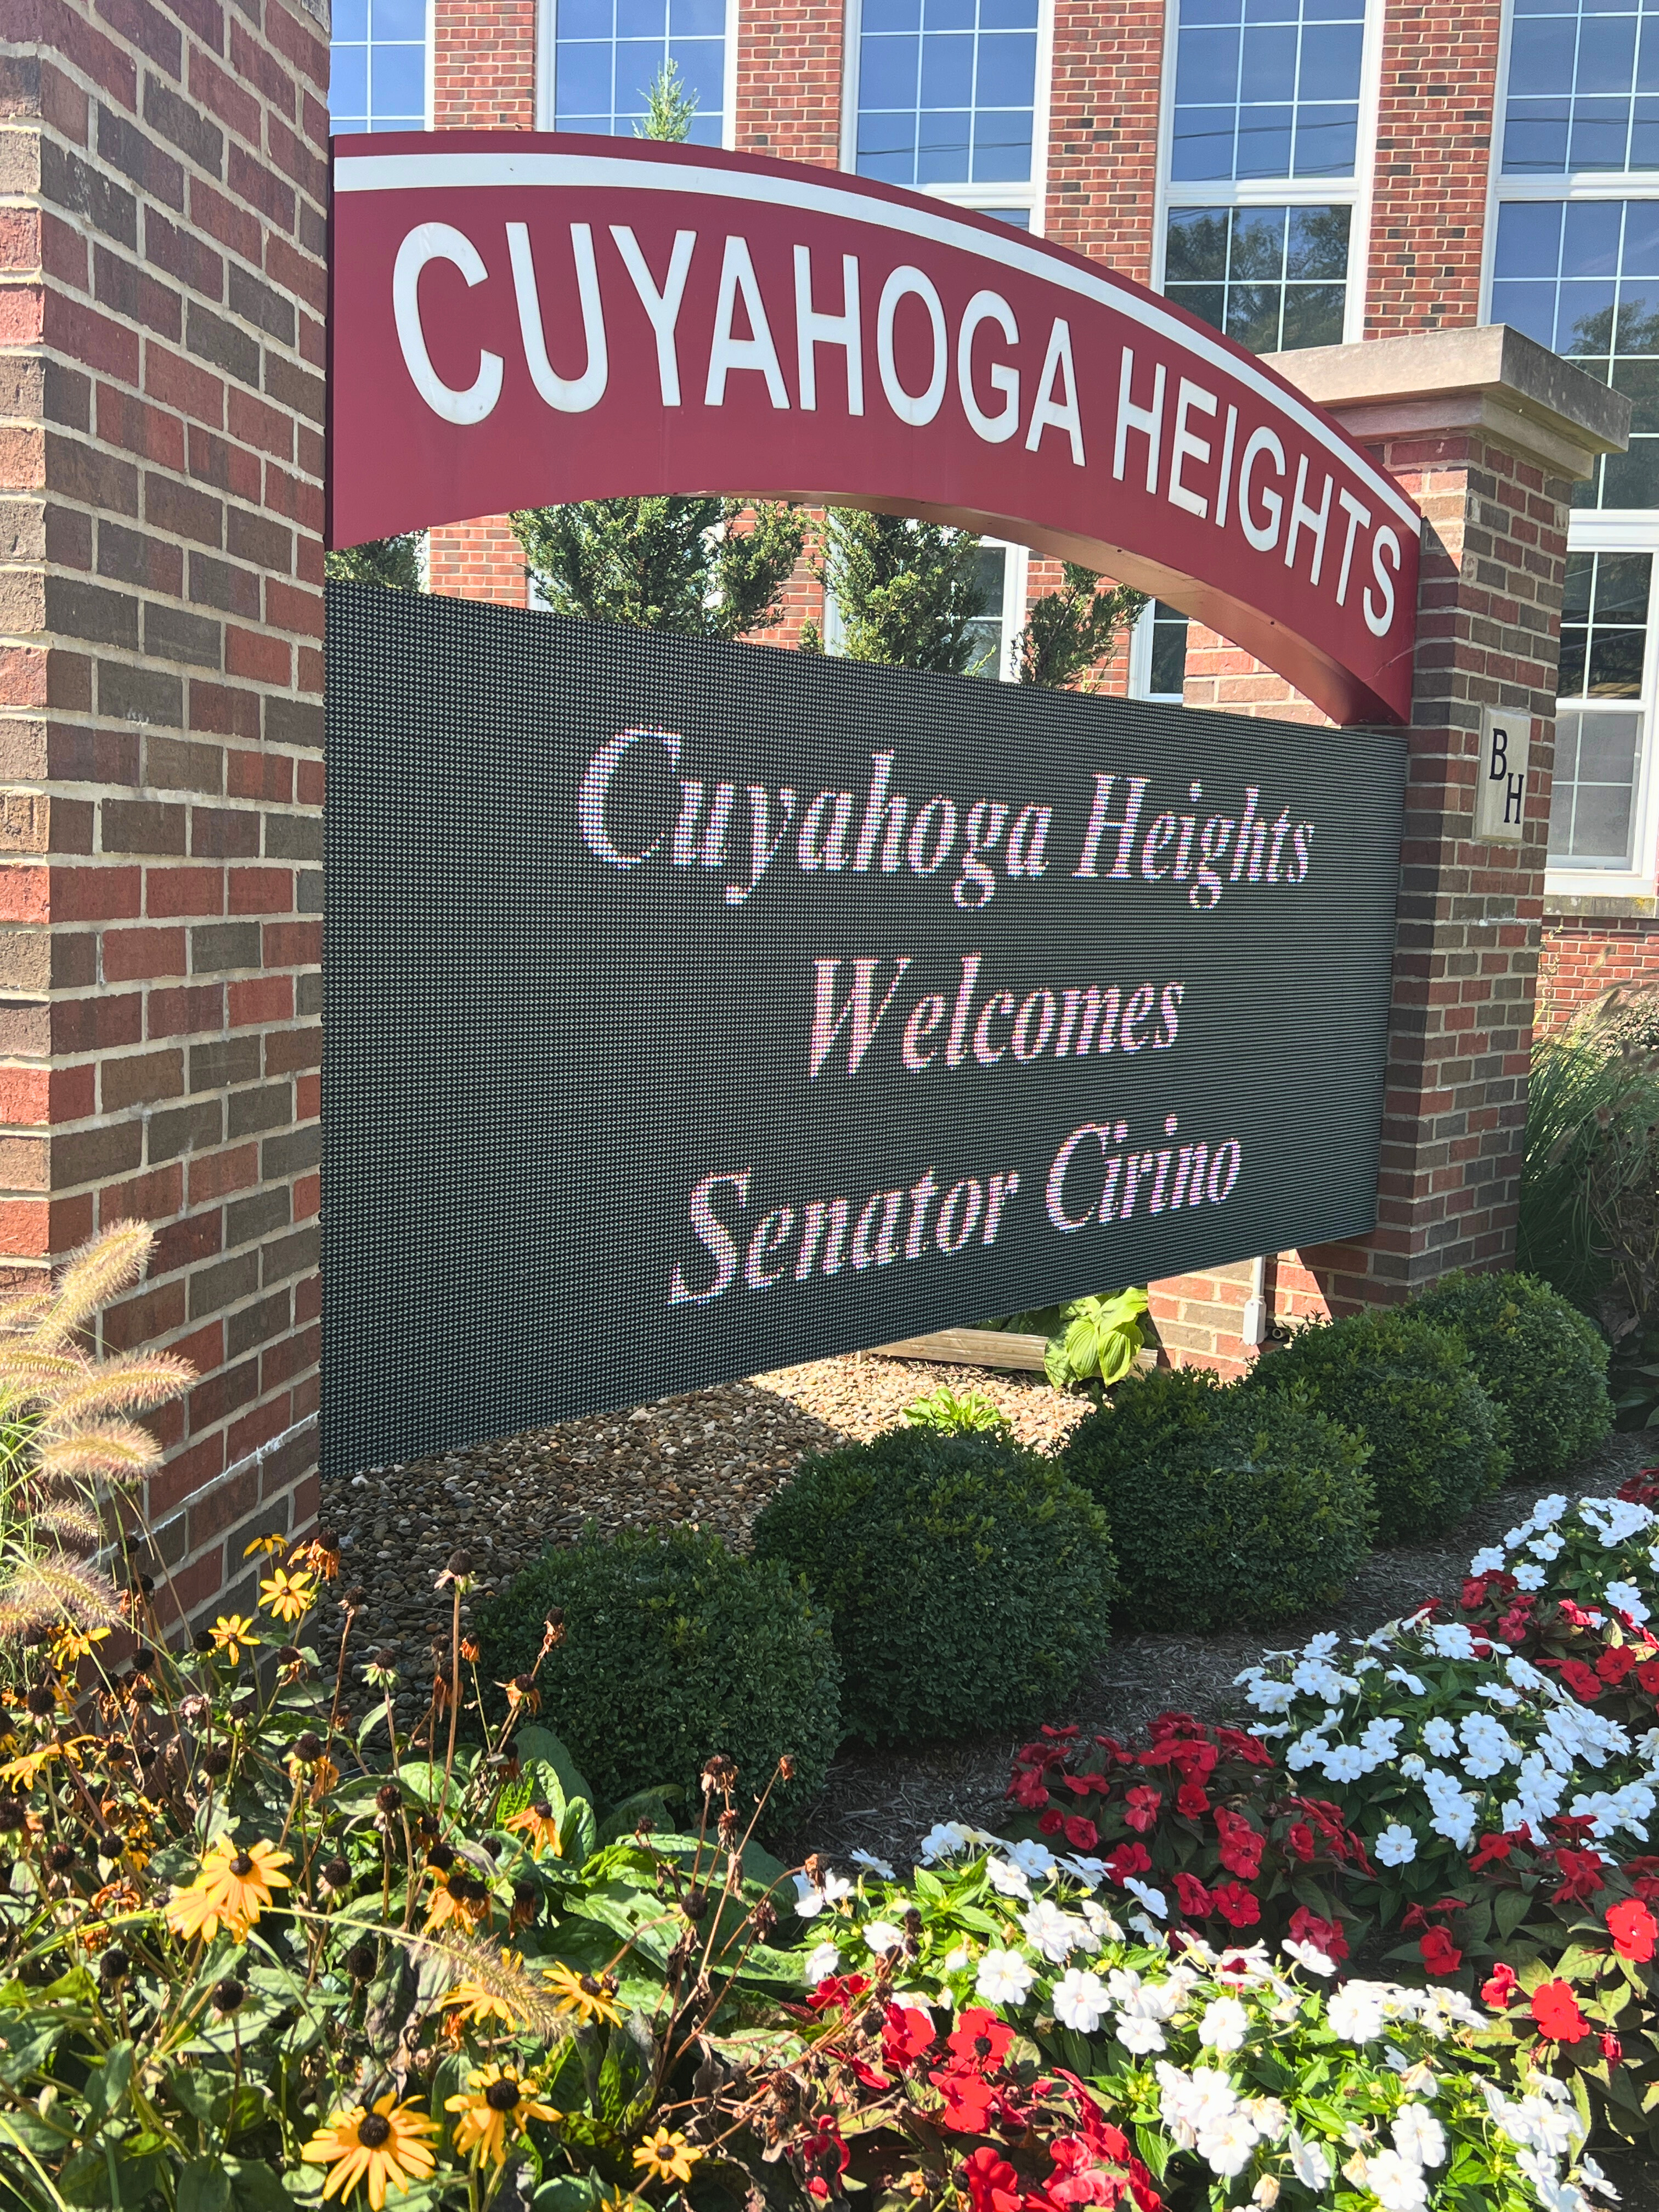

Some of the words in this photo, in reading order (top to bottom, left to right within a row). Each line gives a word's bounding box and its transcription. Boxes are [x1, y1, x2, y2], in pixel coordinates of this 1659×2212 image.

[393, 222, 1085, 466] CUYAHOGA
[1113, 346, 1401, 637] HEIGHTS
[579, 723, 1052, 909] Cuyahoga
[1071, 772, 1314, 910] Heights
[809, 952, 1186, 1079] Welcomes
[667, 1167, 1020, 1306] Senator
[1046, 1113, 1242, 1233] Cirino
